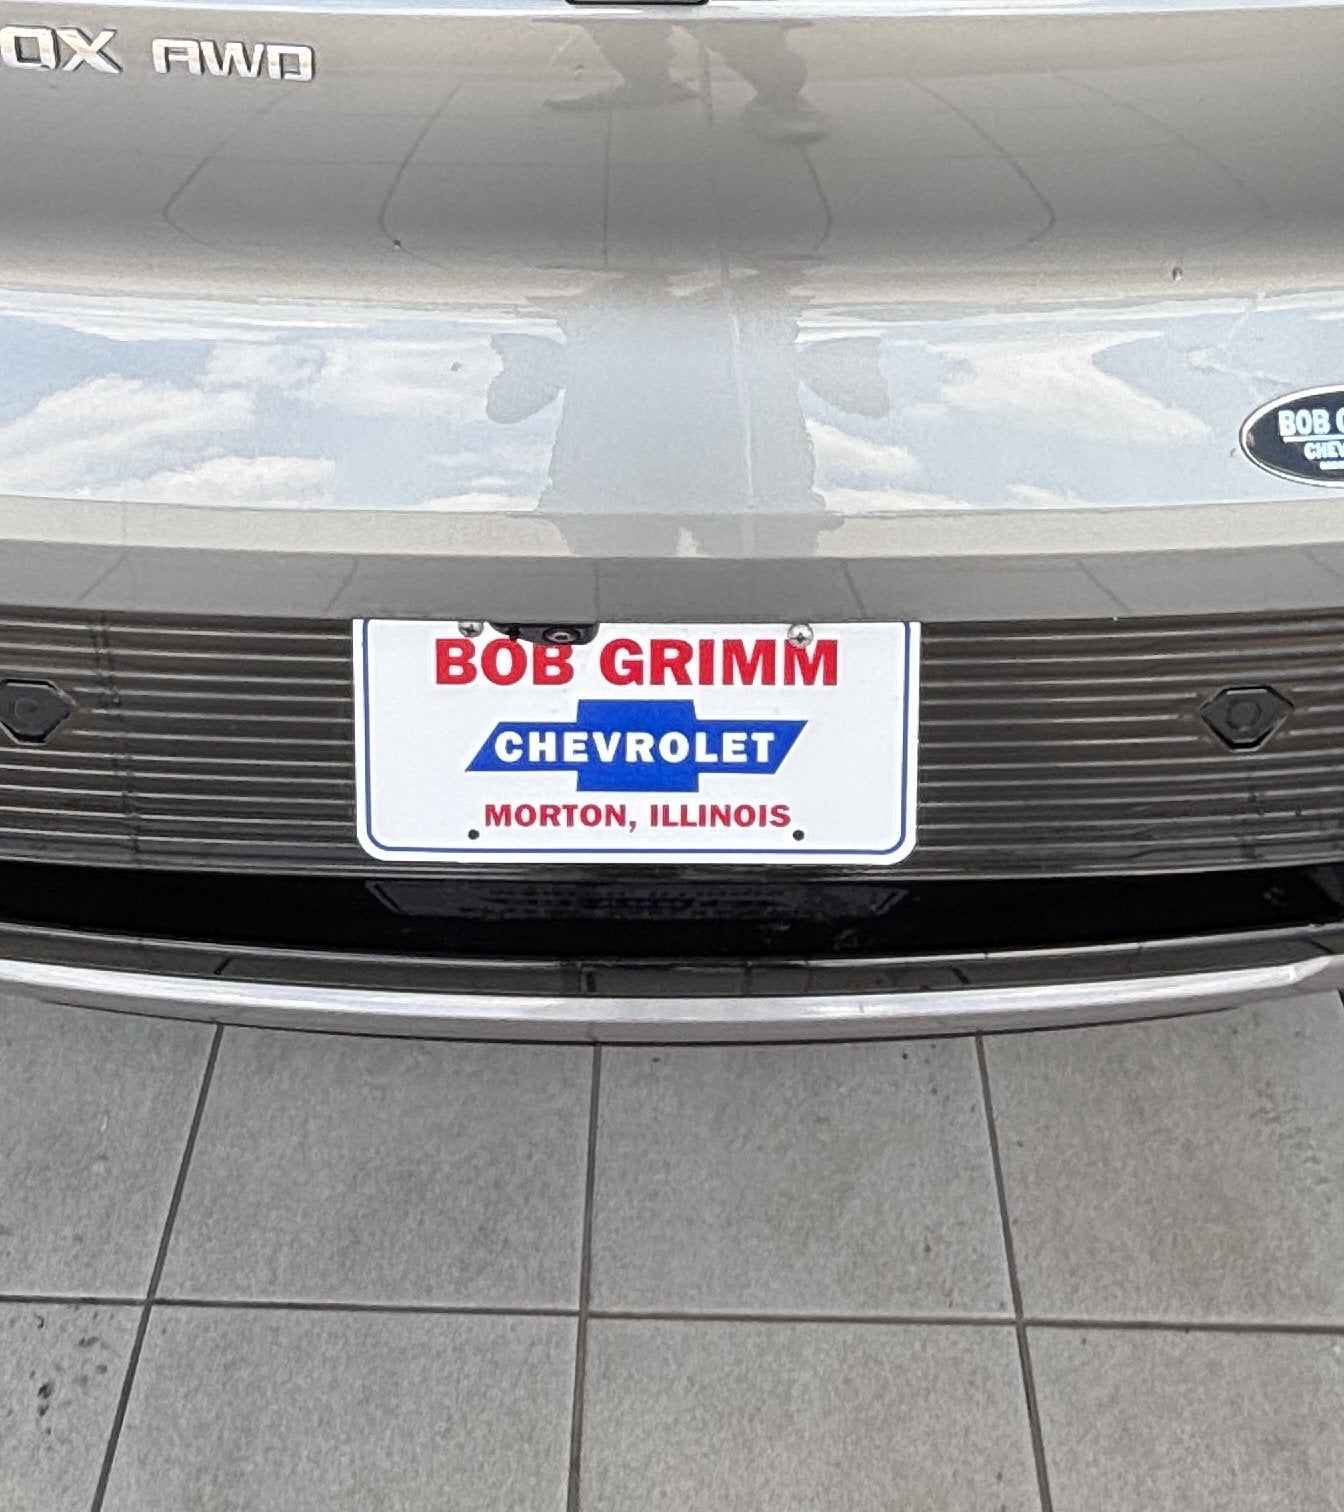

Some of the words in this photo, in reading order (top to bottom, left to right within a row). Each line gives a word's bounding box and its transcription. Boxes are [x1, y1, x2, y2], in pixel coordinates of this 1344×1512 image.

[152, 38, 316, 82] AWD
[1278, 408, 1331, 436] BOB
[434, 638, 575, 686] BOB
[599, 638, 839, 686] GRIMM
[494, 731, 776, 764] CHEVROLET
[484, 803, 637, 833] MORTON,
[649, 803, 791, 828] ILLINOIS
